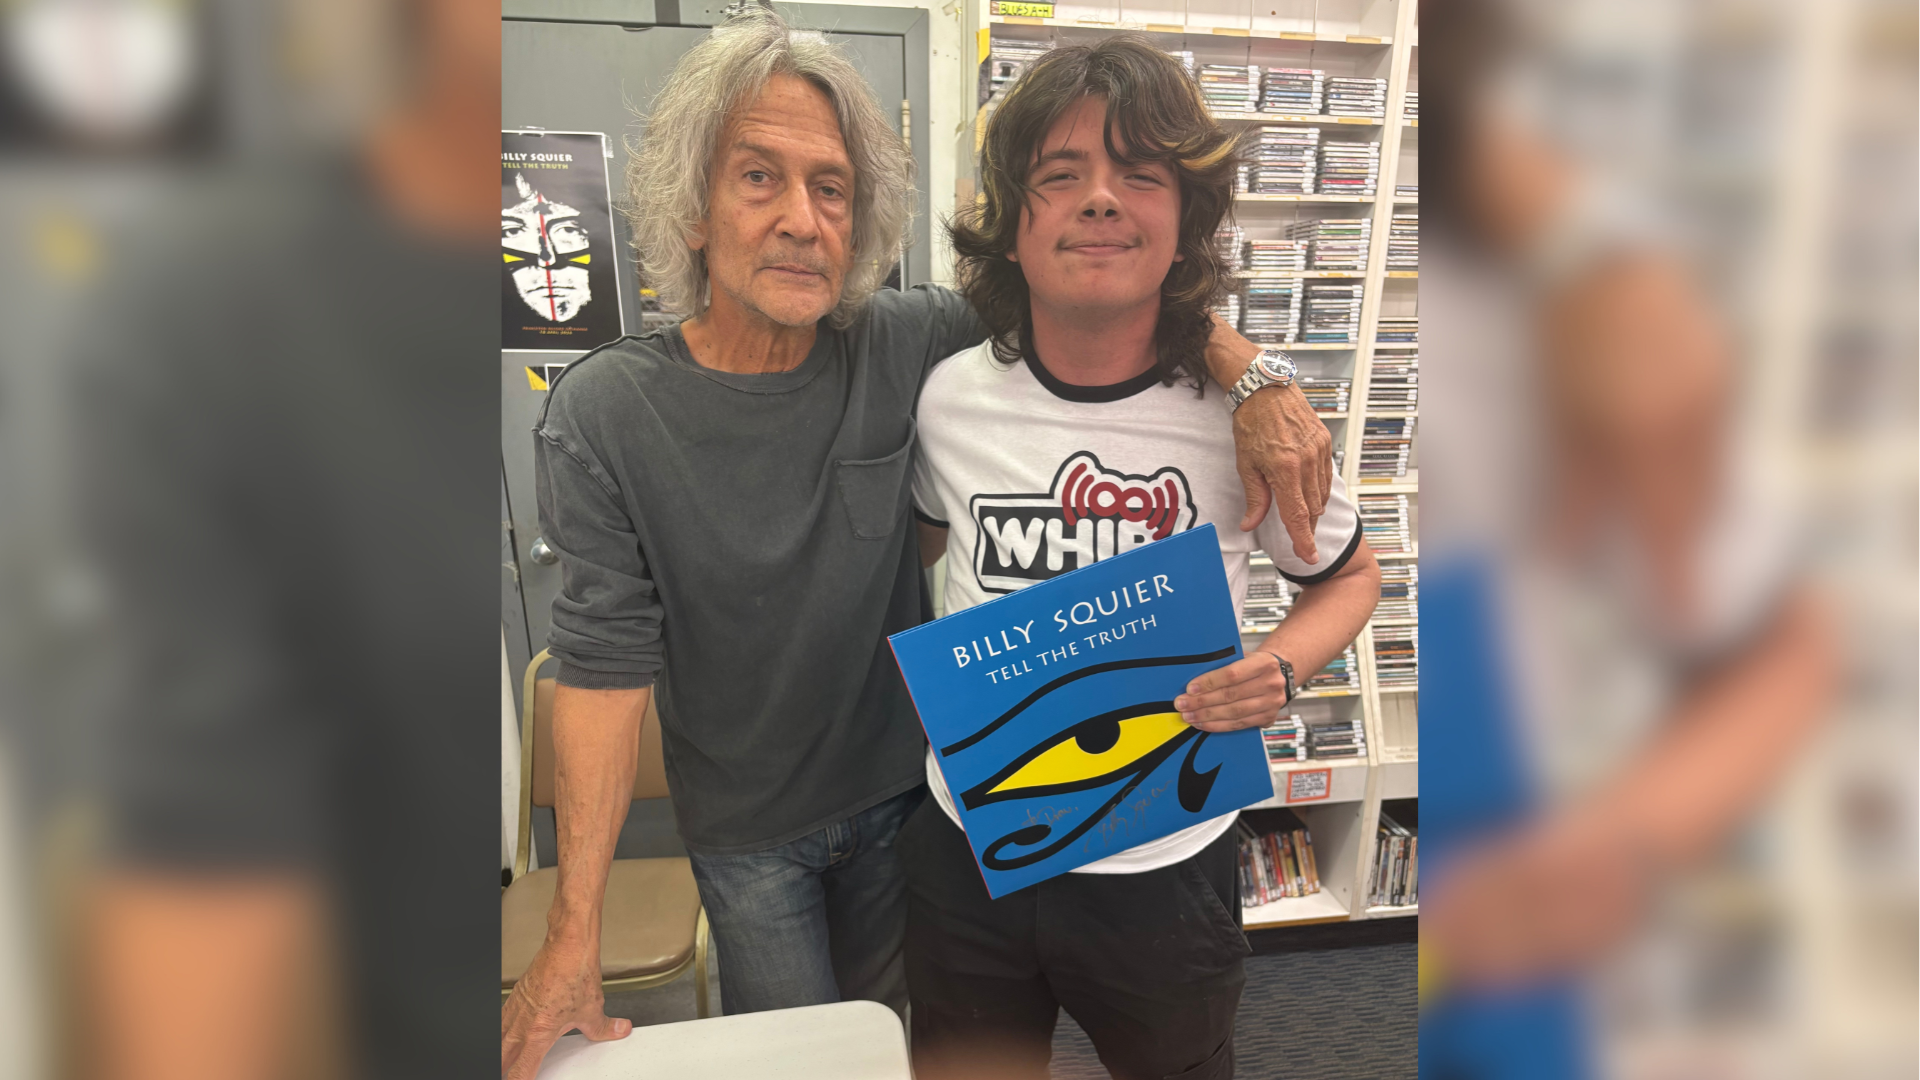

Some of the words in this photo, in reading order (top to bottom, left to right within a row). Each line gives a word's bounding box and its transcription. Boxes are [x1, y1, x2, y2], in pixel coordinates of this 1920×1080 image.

[1000, 3, 1028, 16] BLUES
[530, 153, 573, 162] SQUIER
[952, 619, 1035, 668] BILLY
[1053, 574, 1174, 633] SQUIER
[985, 659, 1033, 684] TELL
[1036, 641, 1080, 666] THE
[1083, 614, 1157, 649] TRUTH
